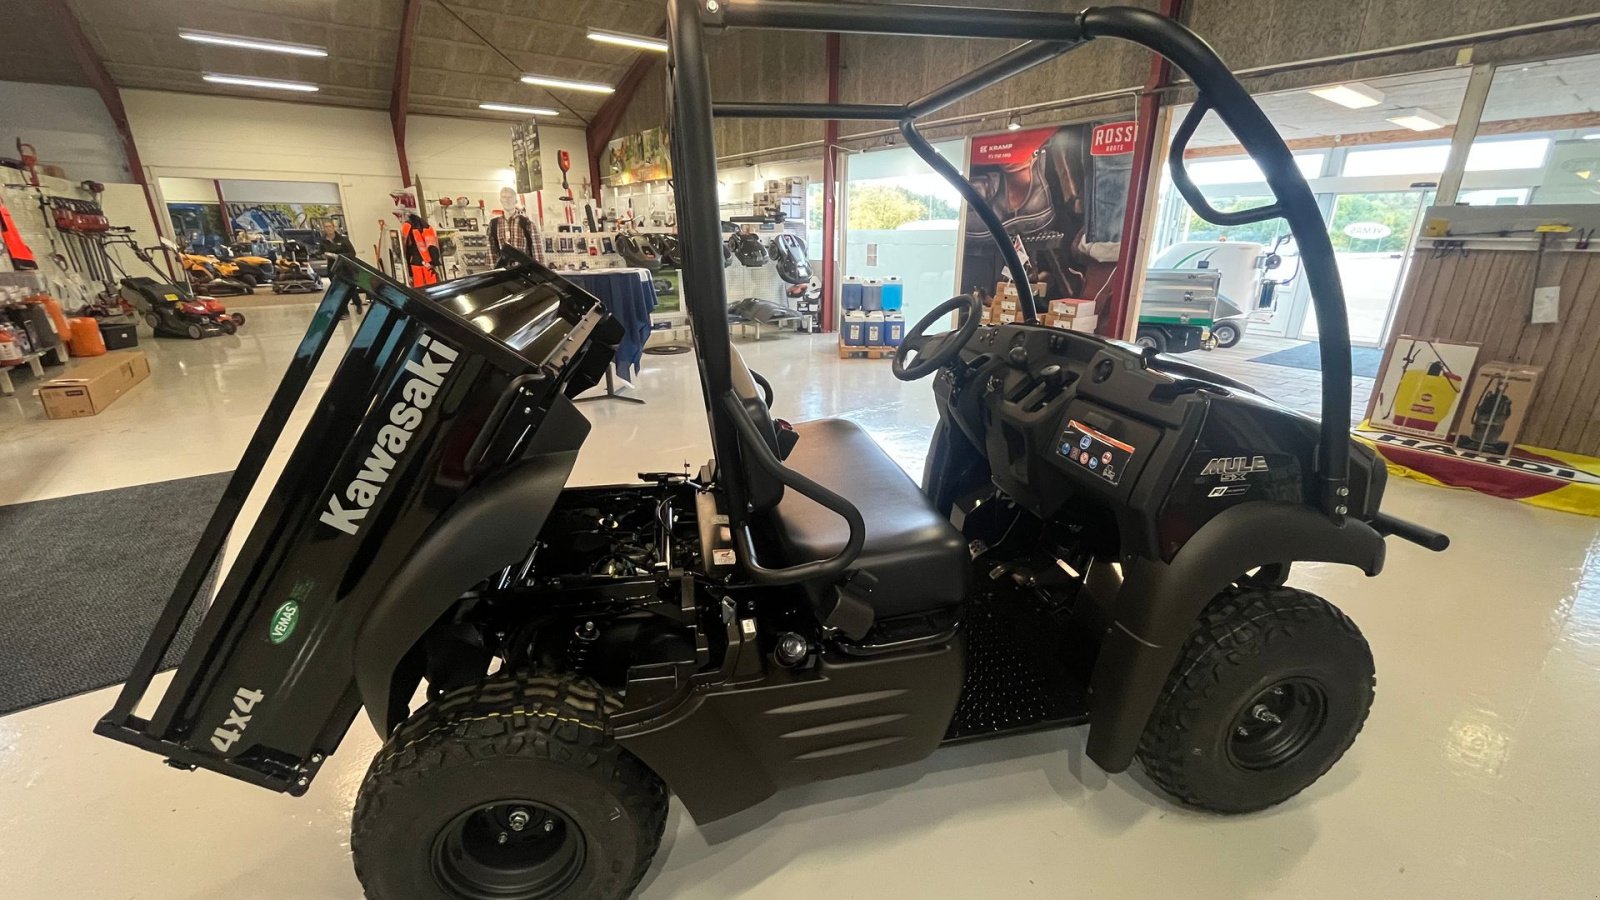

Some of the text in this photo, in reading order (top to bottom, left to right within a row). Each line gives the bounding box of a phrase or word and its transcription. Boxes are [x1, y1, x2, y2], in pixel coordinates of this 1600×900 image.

[988, 143, 1013, 152] KRAMP
[319, 333, 459, 536] Kawasaki
[1200, 455, 1269, 475] MULE
[1220, 472, 1247, 482] SX
[271, 605, 297, 636] VEMAS
[210, 687, 265, 753] 4x4
